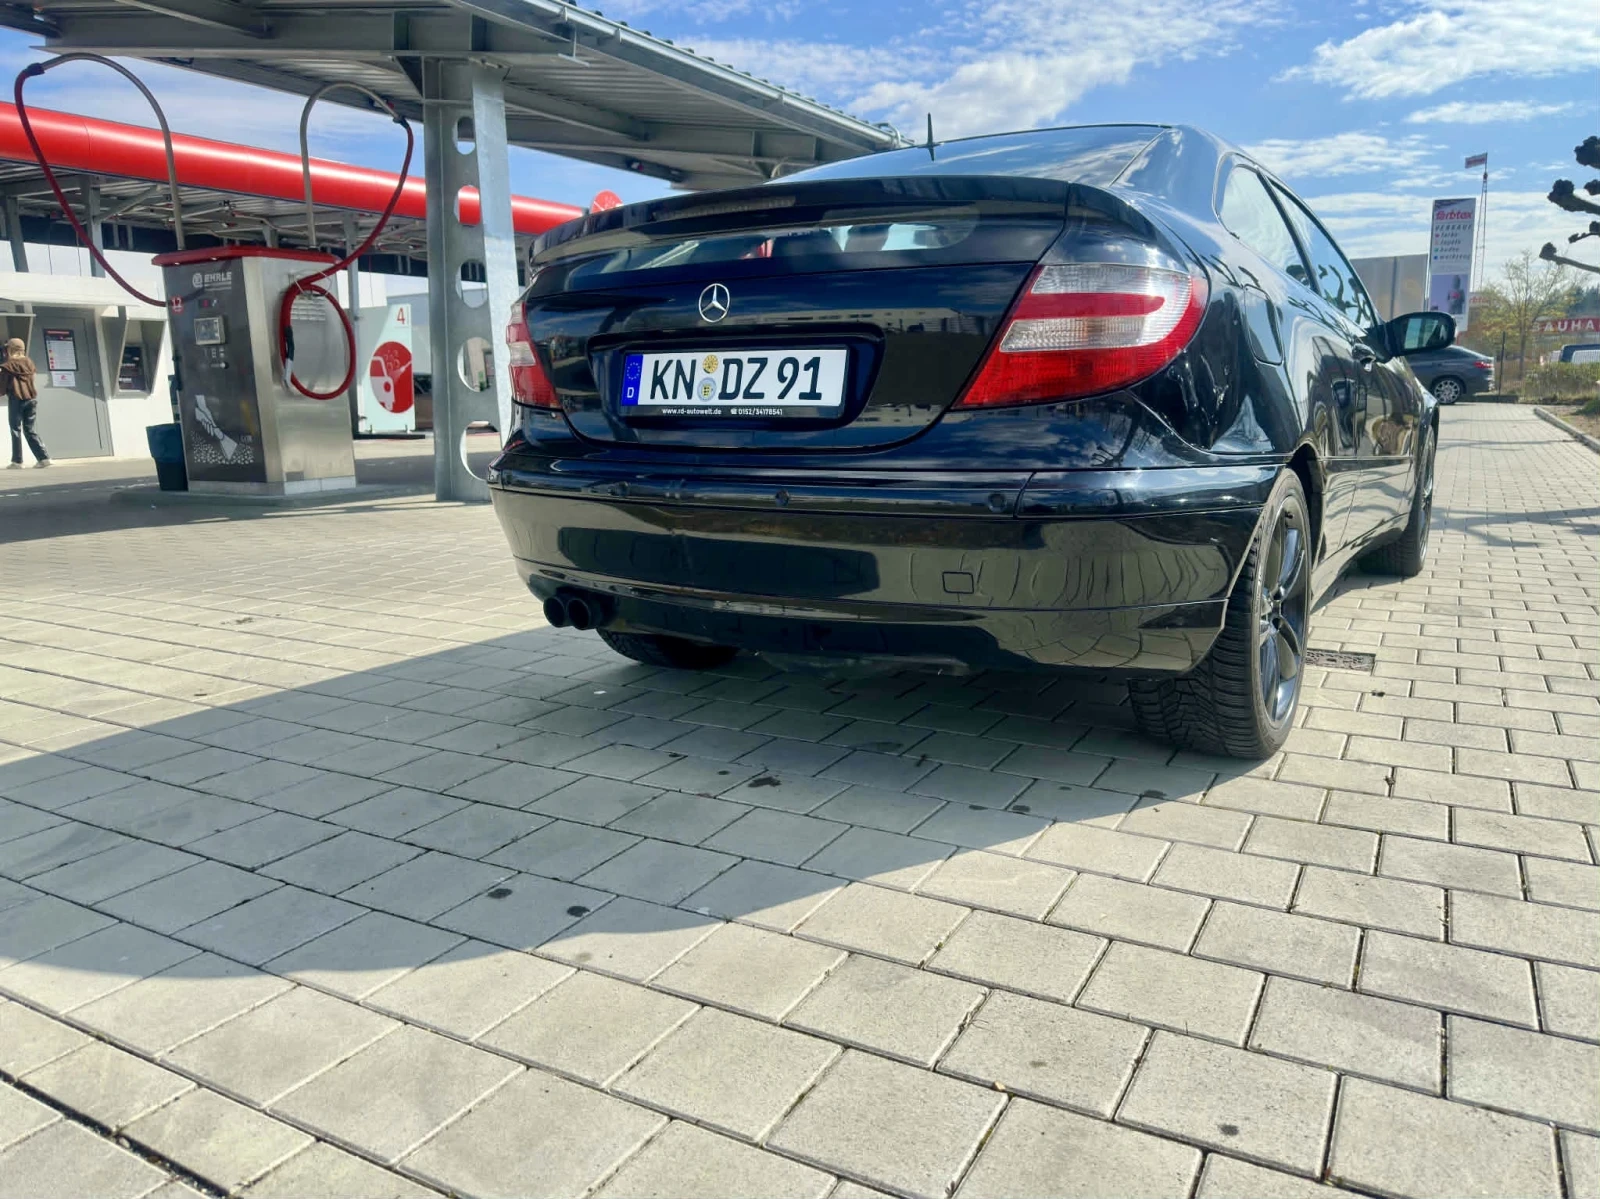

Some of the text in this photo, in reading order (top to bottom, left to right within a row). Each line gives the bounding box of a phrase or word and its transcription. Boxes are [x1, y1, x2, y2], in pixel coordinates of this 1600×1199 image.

[204, 271, 232, 283] EHRLE
[396, 307, 405, 325] 4
[650, 356, 822, 400] KN DZ 91
[627, 387, 635, 398] D
